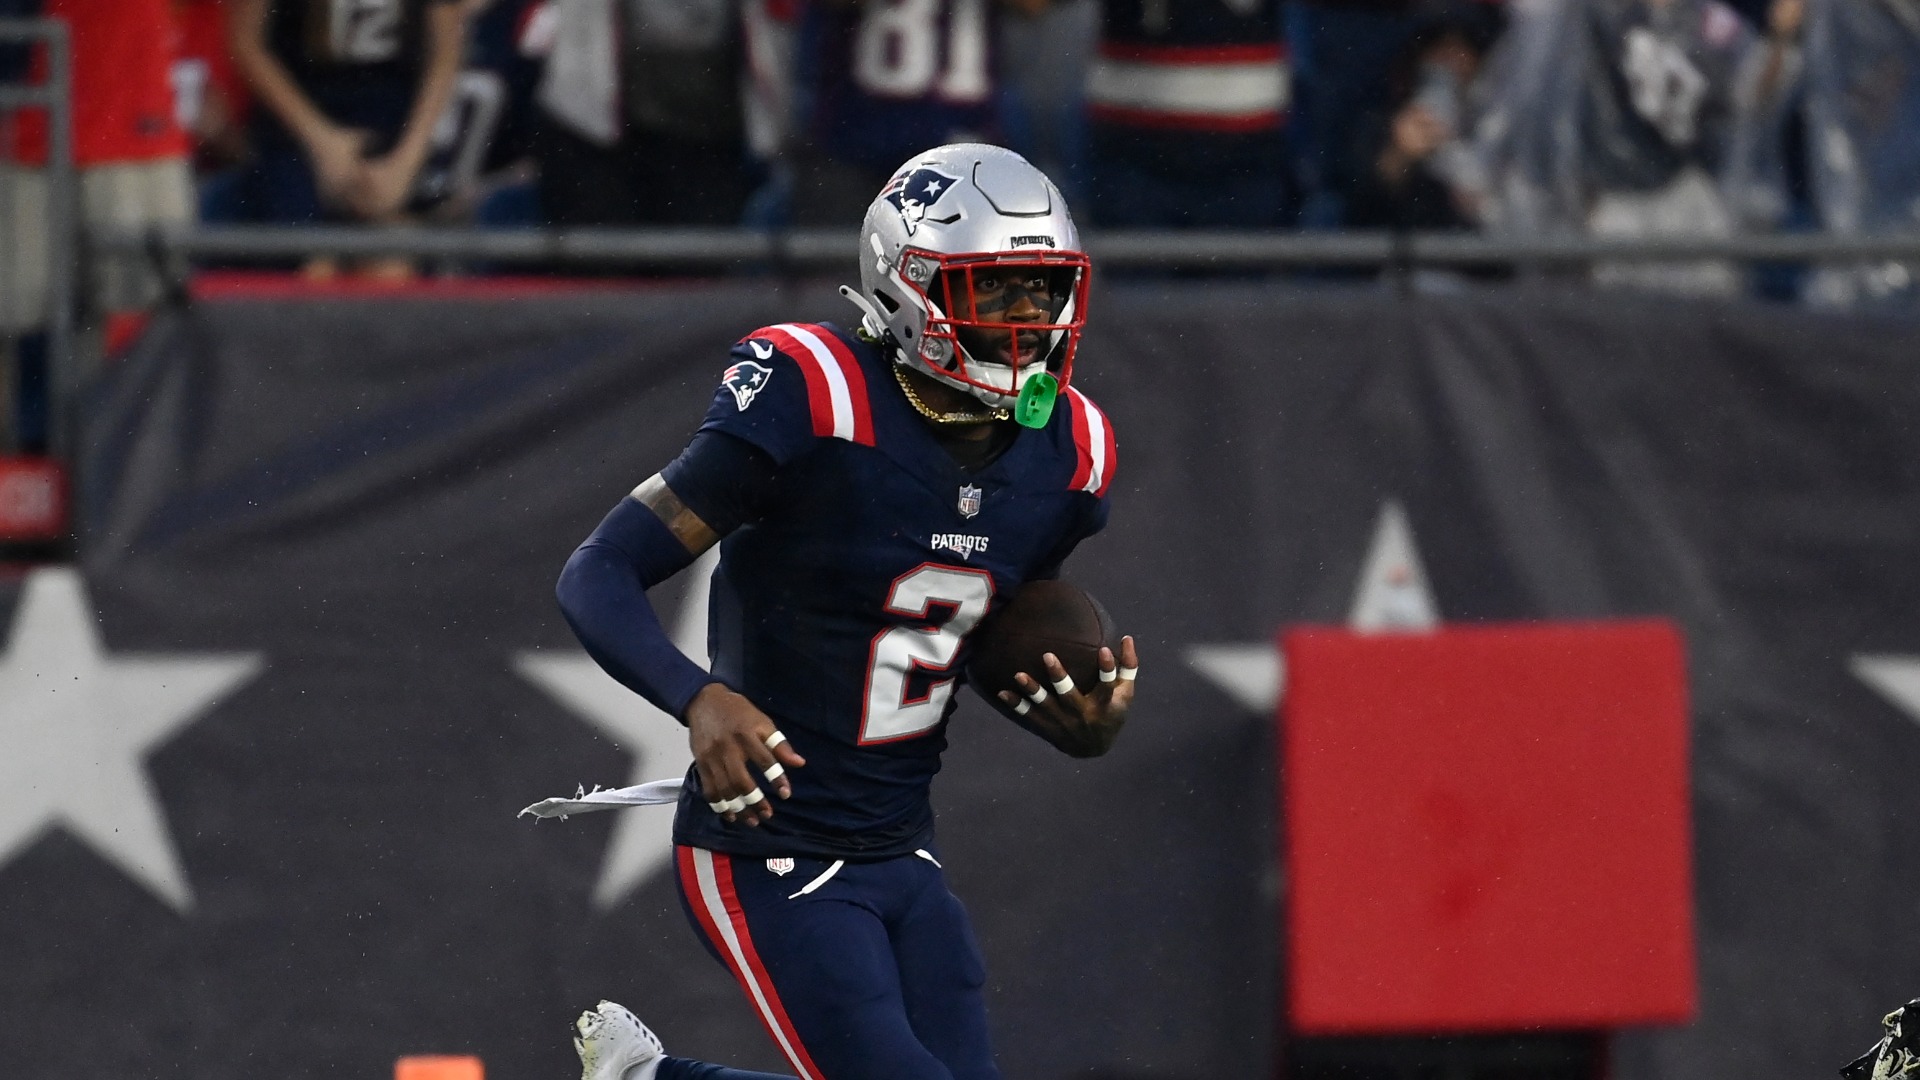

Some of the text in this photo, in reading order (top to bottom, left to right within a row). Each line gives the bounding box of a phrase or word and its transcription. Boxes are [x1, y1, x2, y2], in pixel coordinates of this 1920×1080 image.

[1010, 235, 1055, 249] PATRIOTS
[962, 499, 979, 513] NFL
[931, 533, 989, 552] PATRIOTS
[857, 562, 996, 746] 2
[771, 858, 790, 869] NFL
